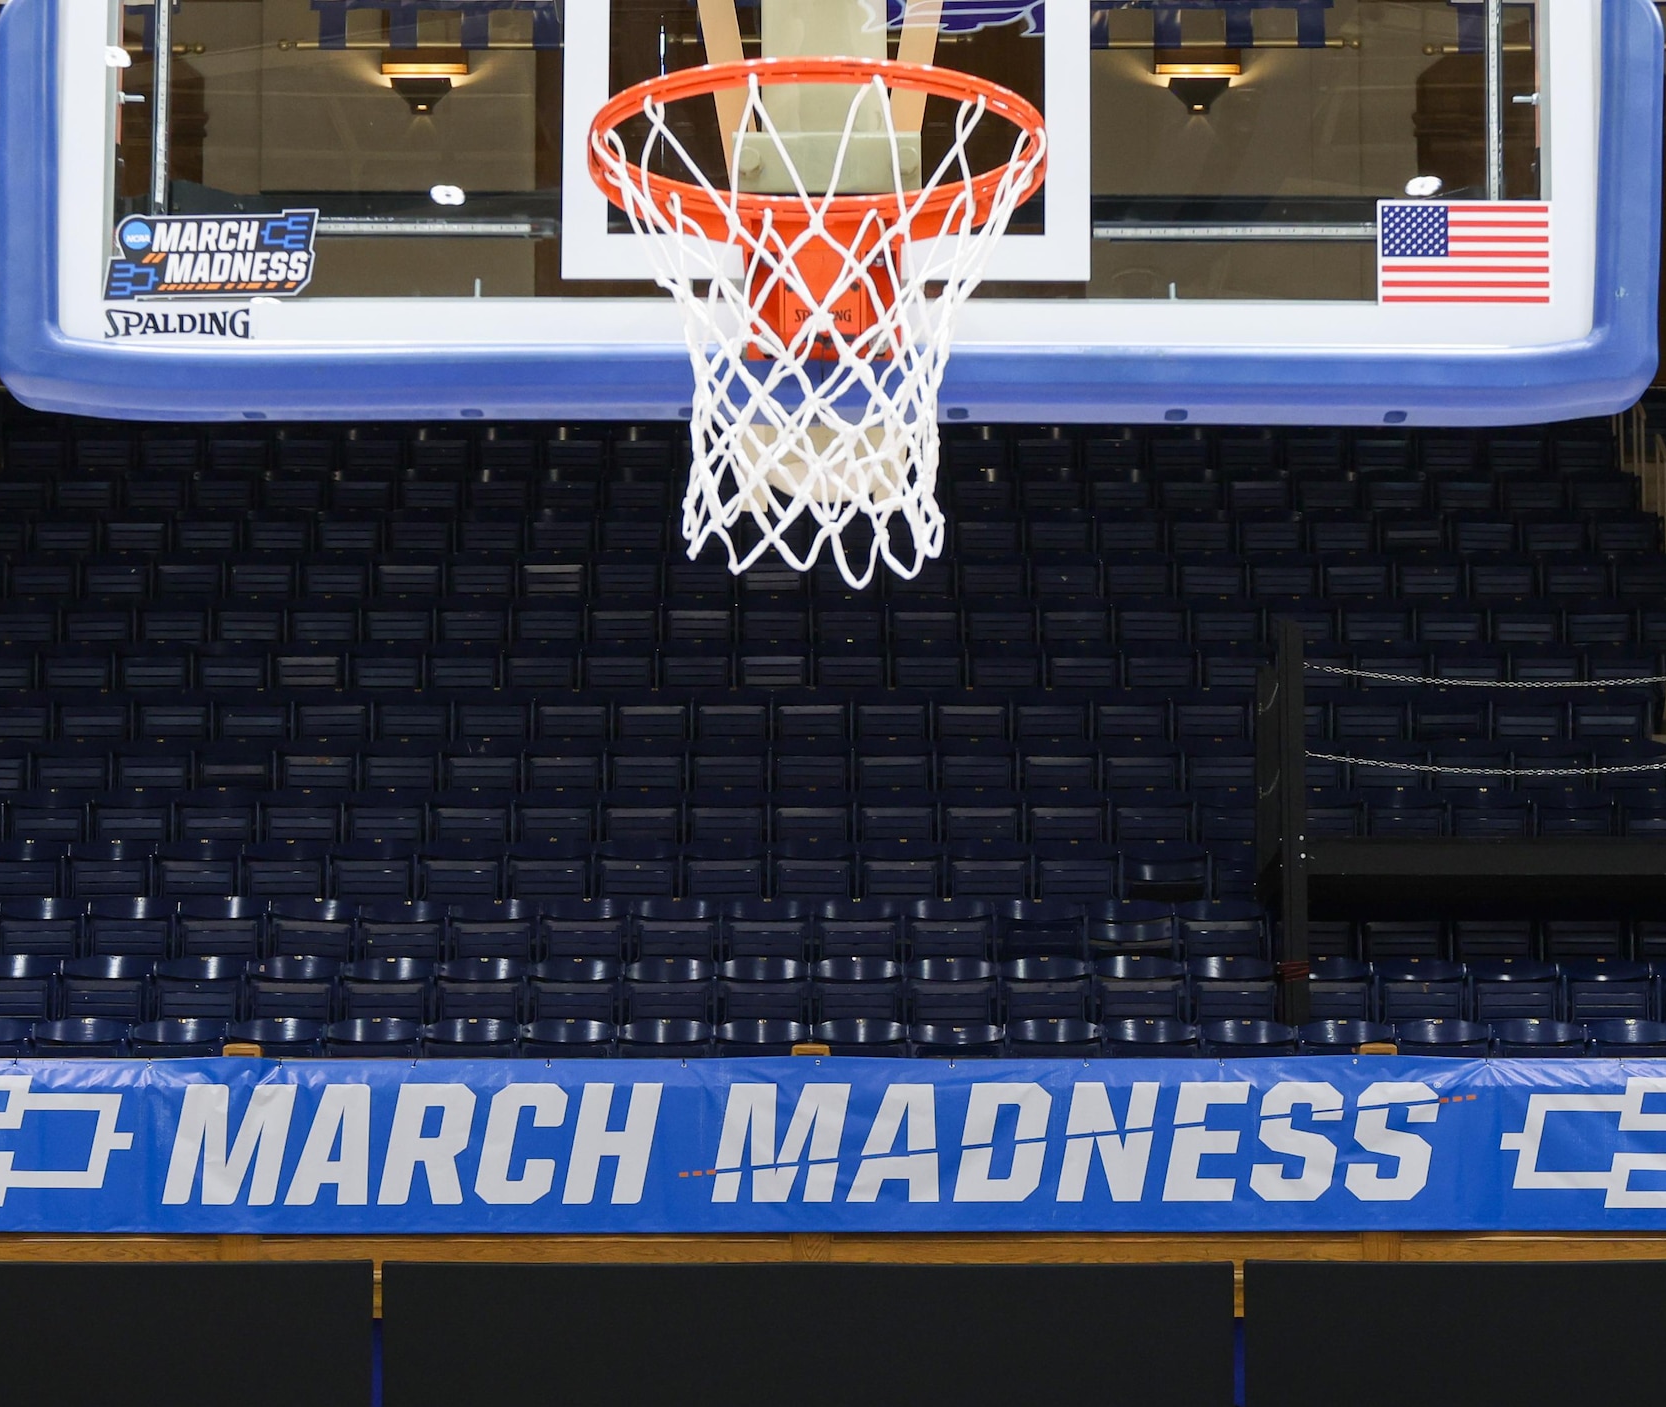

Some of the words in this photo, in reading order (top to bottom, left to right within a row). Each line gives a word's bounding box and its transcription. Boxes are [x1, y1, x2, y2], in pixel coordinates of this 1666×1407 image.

[152, 221, 259, 252] MARCH
[164, 251, 309, 283] MADNESS
[104, 308, 250, 339] SPALDING
[162, 1083, 663, 1205] MARCH
[712, 1082, 1440, 1203] MADNESS
